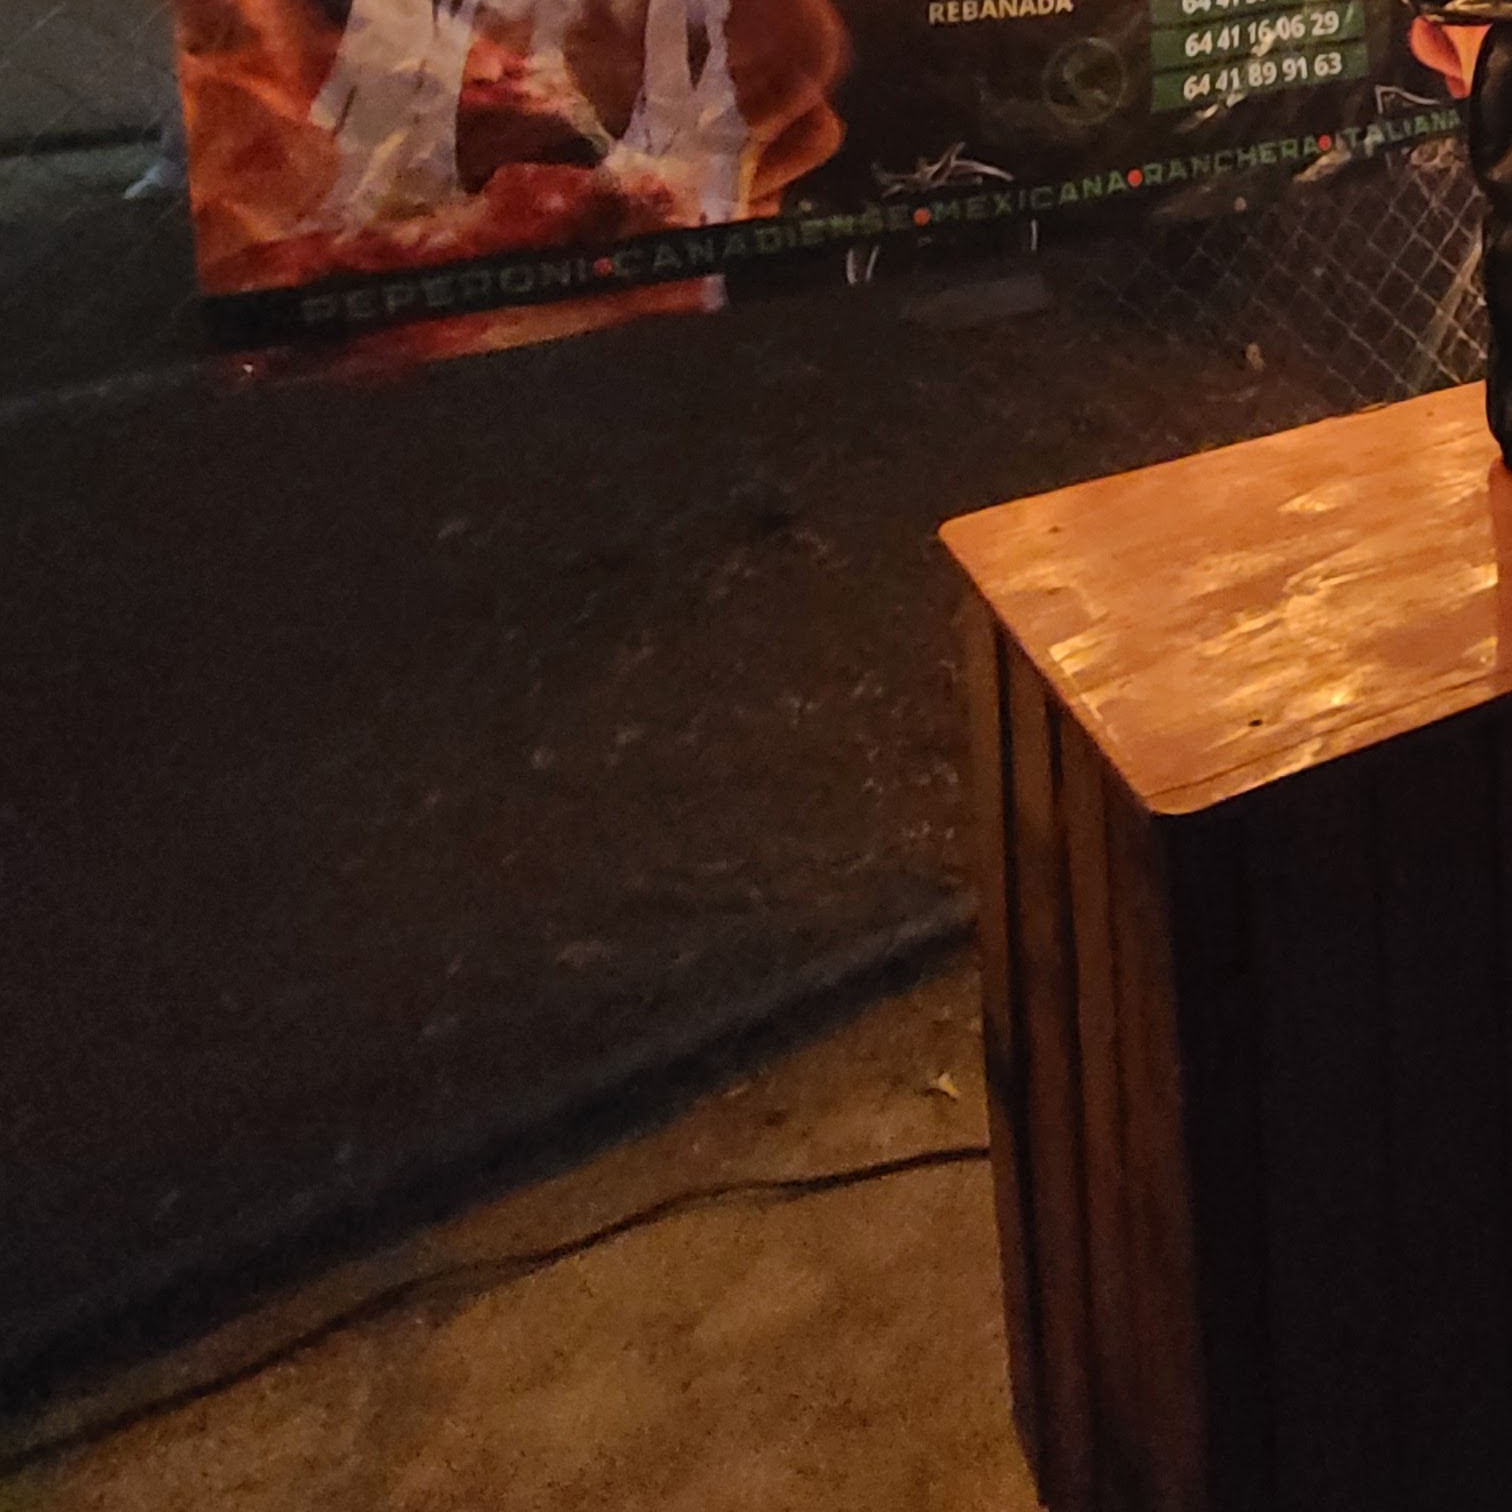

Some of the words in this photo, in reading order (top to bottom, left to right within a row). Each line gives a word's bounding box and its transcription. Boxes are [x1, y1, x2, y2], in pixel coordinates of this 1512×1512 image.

[1185, 30, 1213, 57] 64
[1217, 24, 1240, 50] 41
[1310, 10, 1340, 36] 29
[1183, 73, 1211, 100] 64
[1215, 67, 1240, 92] 41
[1248, 62, 1278, 87] 89
[1282, 56, 1308, 81] 91
[1314, 52, 1342, 76] 63
[931, 172, 1127, 222] MEXICANA
[1142, 136, 1320, 187] RANCHERA
